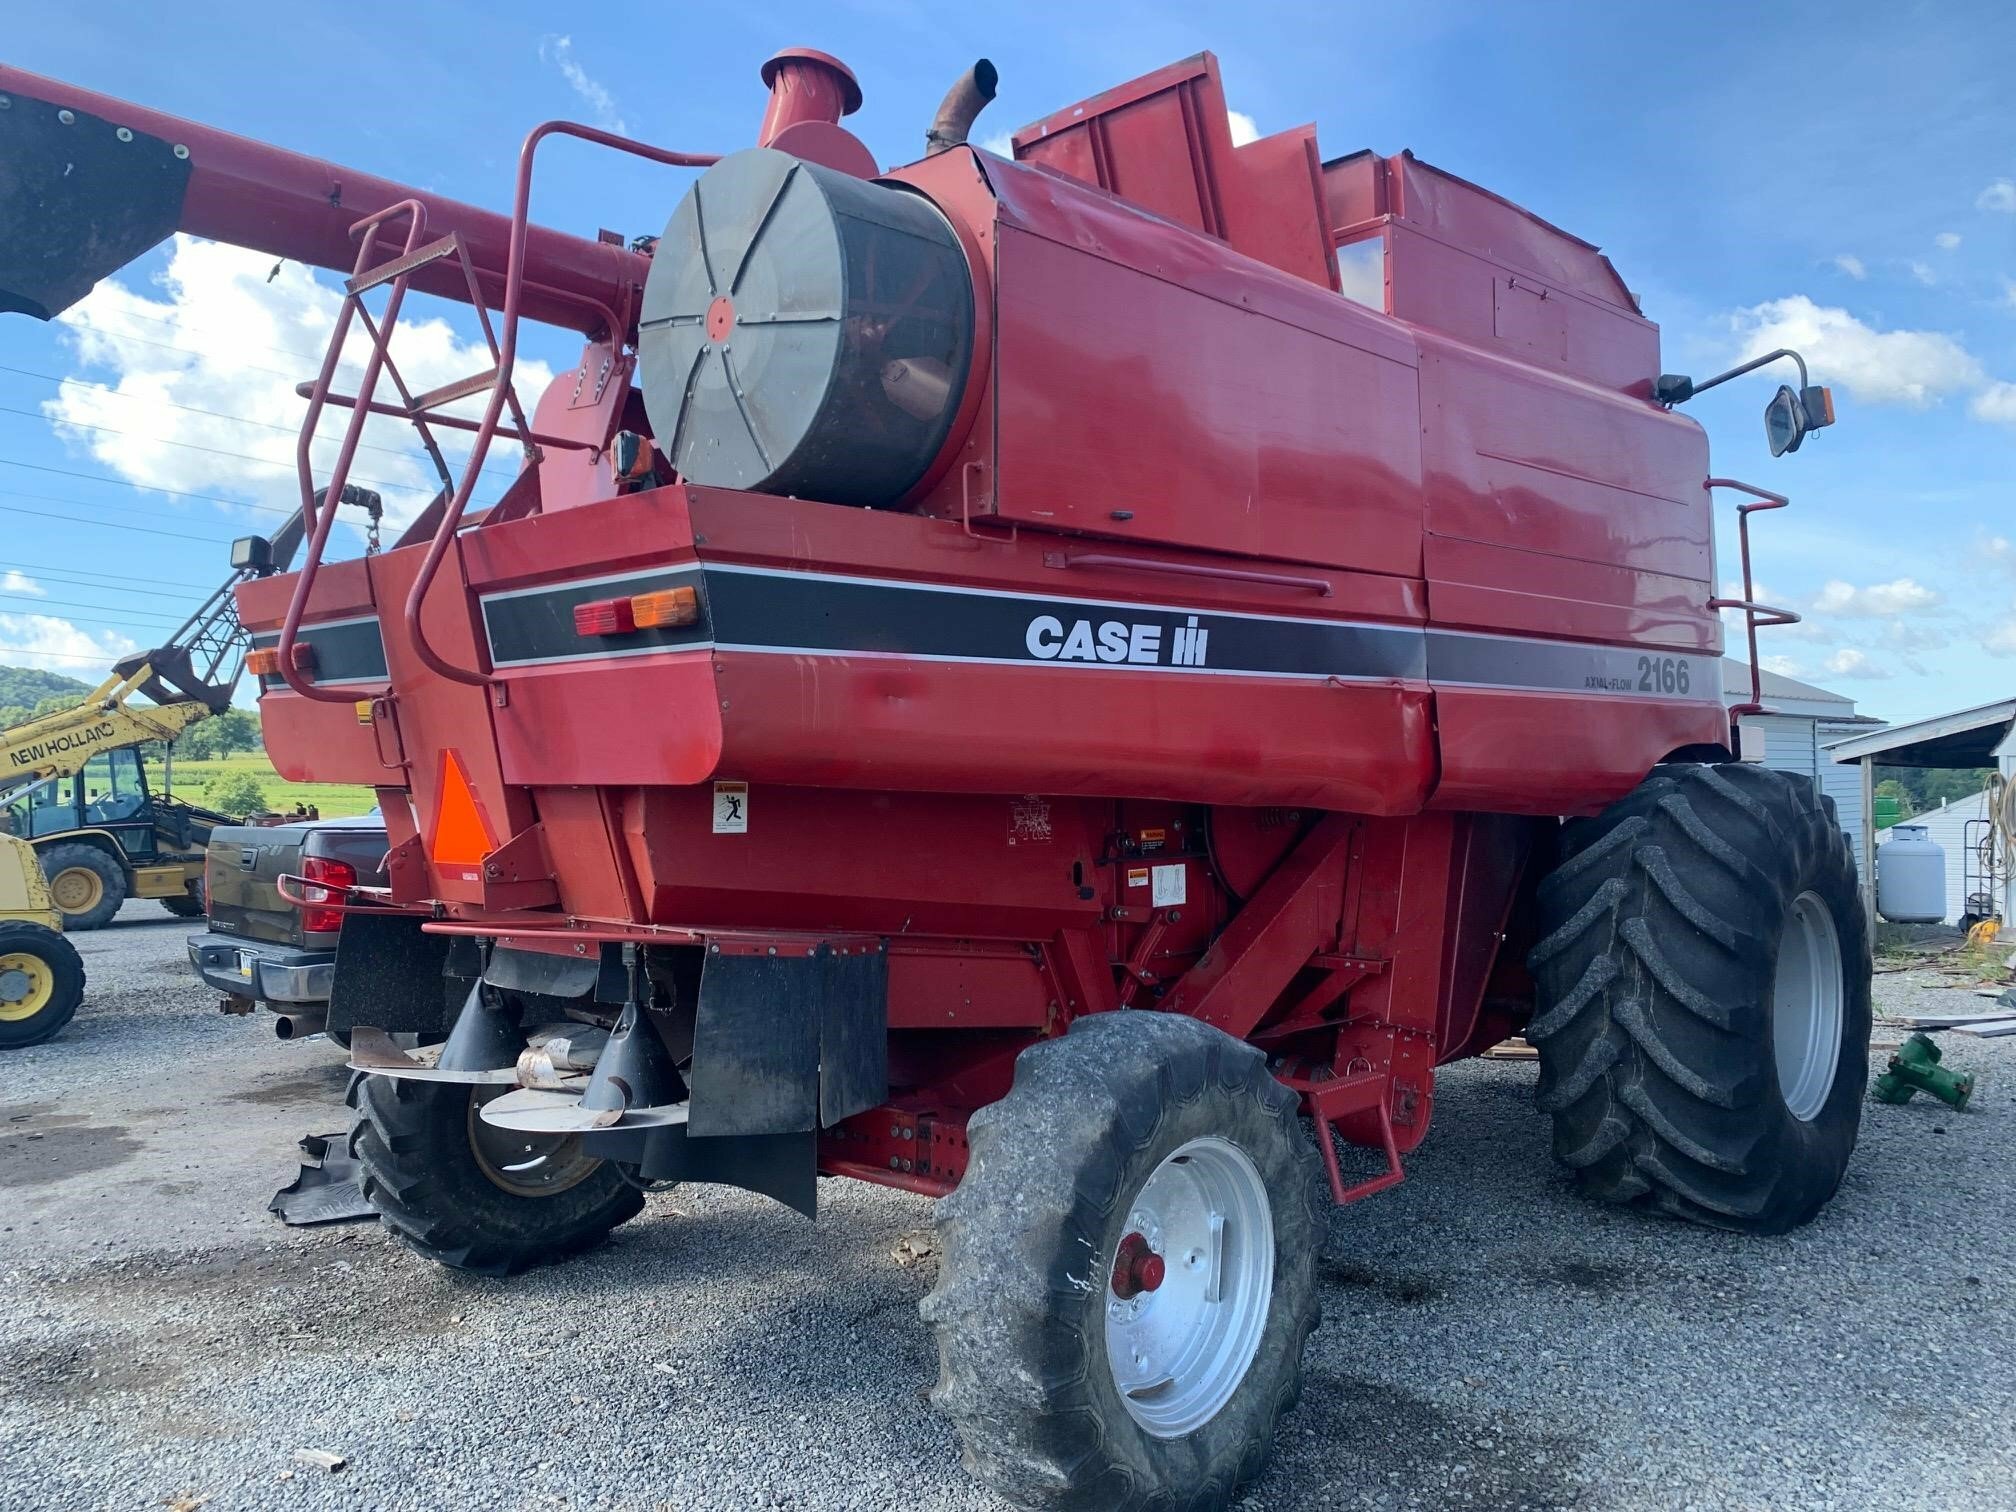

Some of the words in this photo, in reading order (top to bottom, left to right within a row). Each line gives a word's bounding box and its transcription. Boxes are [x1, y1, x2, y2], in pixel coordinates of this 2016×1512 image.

[1025, 615, 1162, 664] CASE
[1637, 655, 1690, 695] 2166
[10, 744, 45, 767] NEW
